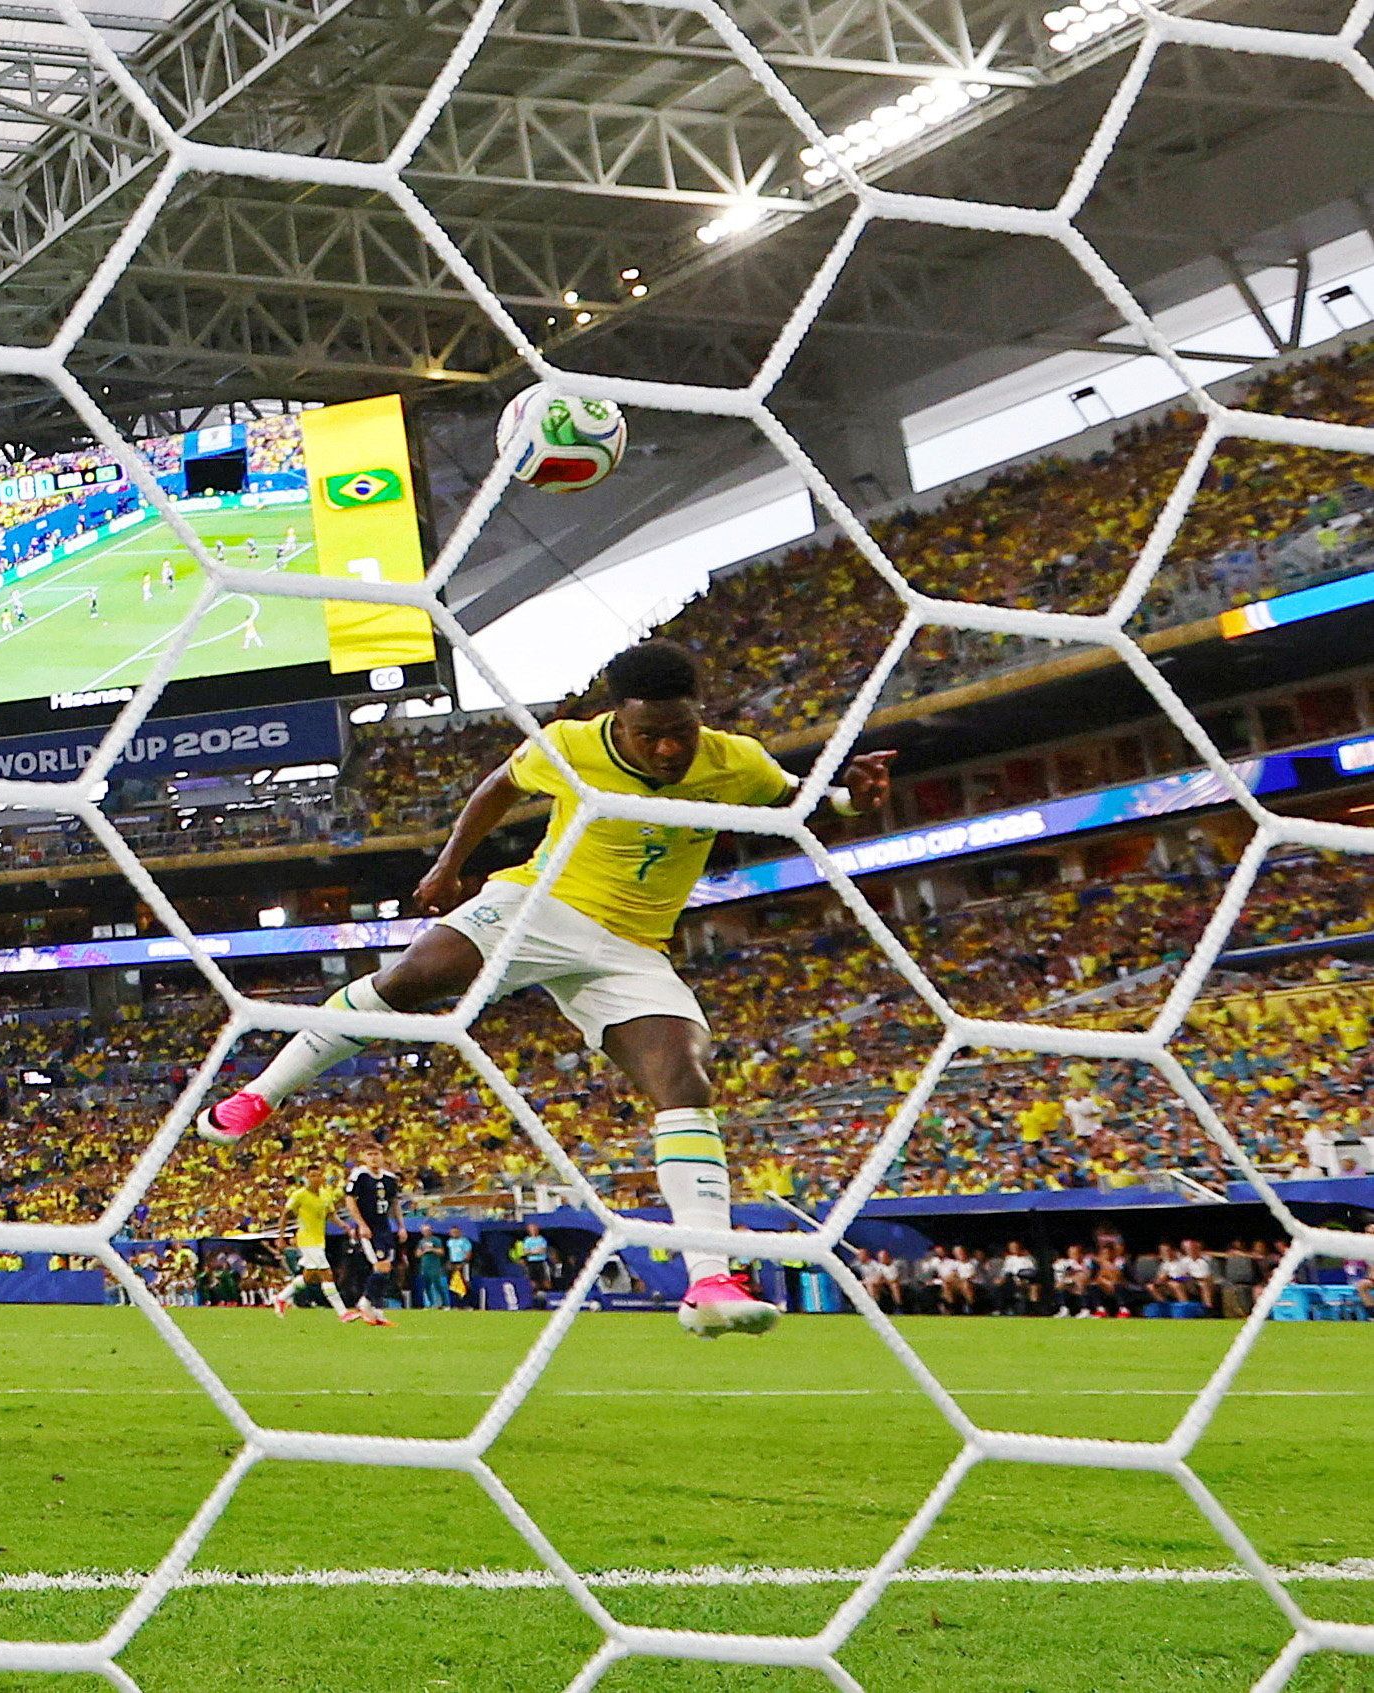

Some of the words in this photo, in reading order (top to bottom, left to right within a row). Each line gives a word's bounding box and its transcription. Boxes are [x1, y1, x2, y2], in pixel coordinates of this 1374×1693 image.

[6, 486, 13, 497] 0
[375, 671, 400, 687] CC
[51, 687, 134, 710] Hisense
[108, 737, 167, 765] UP
[173, 721, 290, 758] 2026
[637, 845, 667, 881] 7
